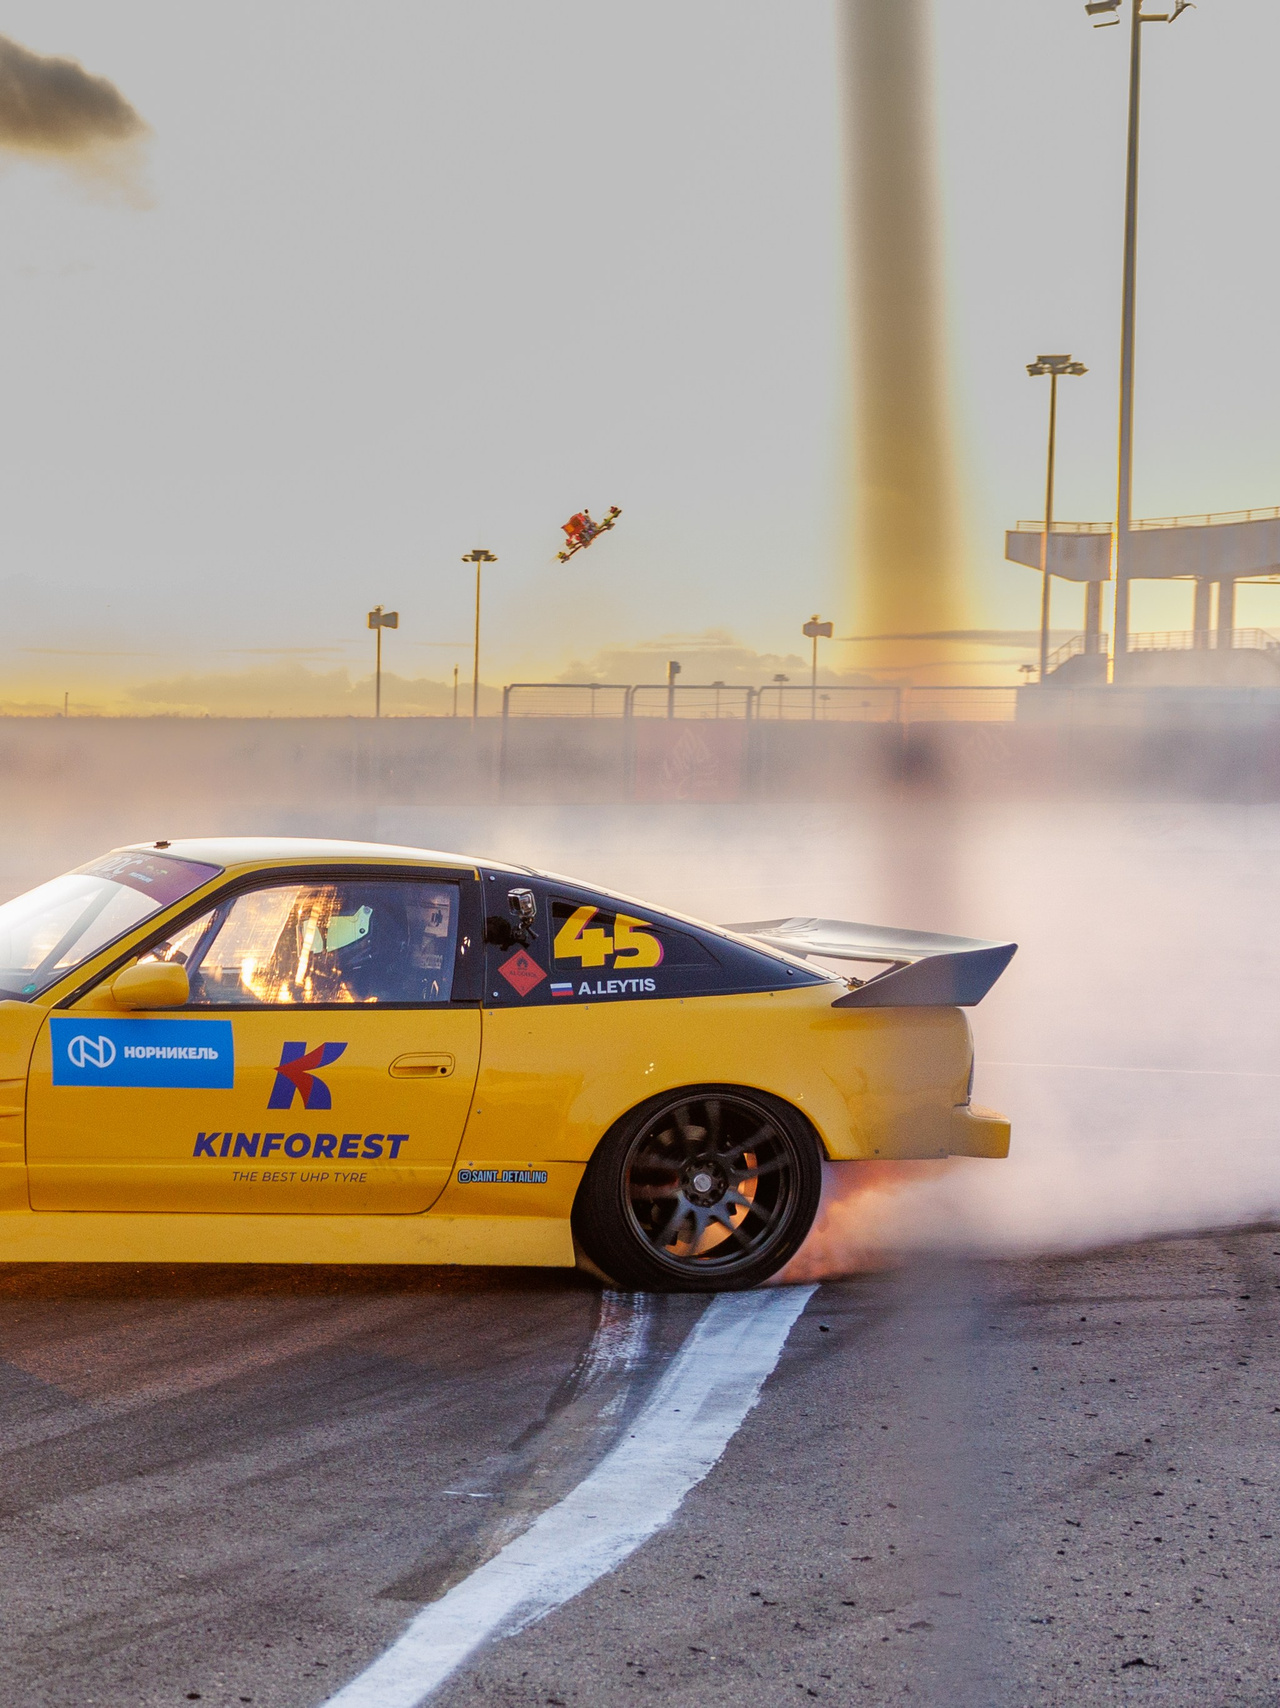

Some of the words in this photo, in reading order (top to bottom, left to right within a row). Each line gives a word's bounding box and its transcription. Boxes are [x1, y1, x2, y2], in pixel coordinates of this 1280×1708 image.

[554, 906, 664, 969] 45
[578, 978, 656, 995] A.LEYTIS
[124, 1046, 219, 1060] НОРНИКЕЛЬ
[192, 1132, 410, 1159] KINFOREST
[232, 1171, 258, 1182] THE
[262, 1171, 297, 1182] BEST
[300, 1172, 329, 1182] UHP
[334, 1172, 367, 1183] TYRE
